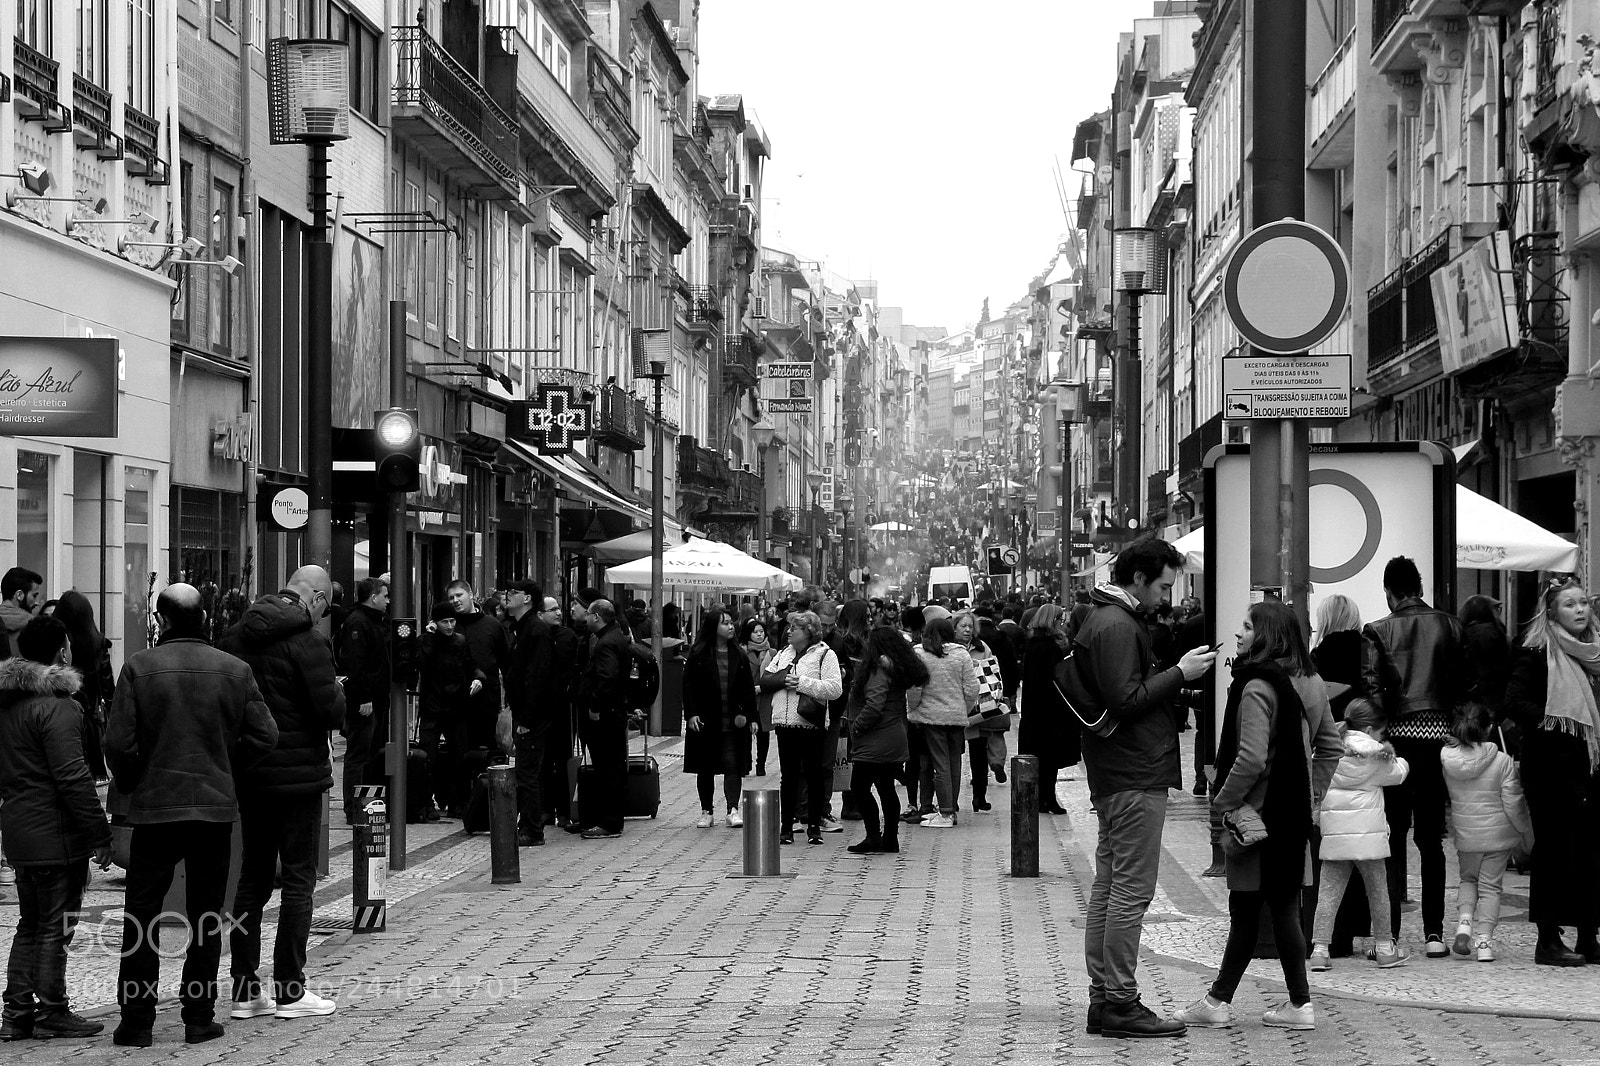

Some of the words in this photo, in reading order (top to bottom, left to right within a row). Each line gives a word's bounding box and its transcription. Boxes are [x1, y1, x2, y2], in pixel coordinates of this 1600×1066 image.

[1254, 392, 1300, 402] TRANSGRESSÃO
[1300, 393, 1323, 402] SUJEITA
[1328, 393, 1348, 401] COIMA
[33, 398, 67, 408] Estética
[1254, 407, 1309, 417] BLOQUEAMENTO
[1310, 408, 1314, 416] E
[1315, 406, 1348, 416] REBOQUE
[538, 412, 576, 428] 12:02
